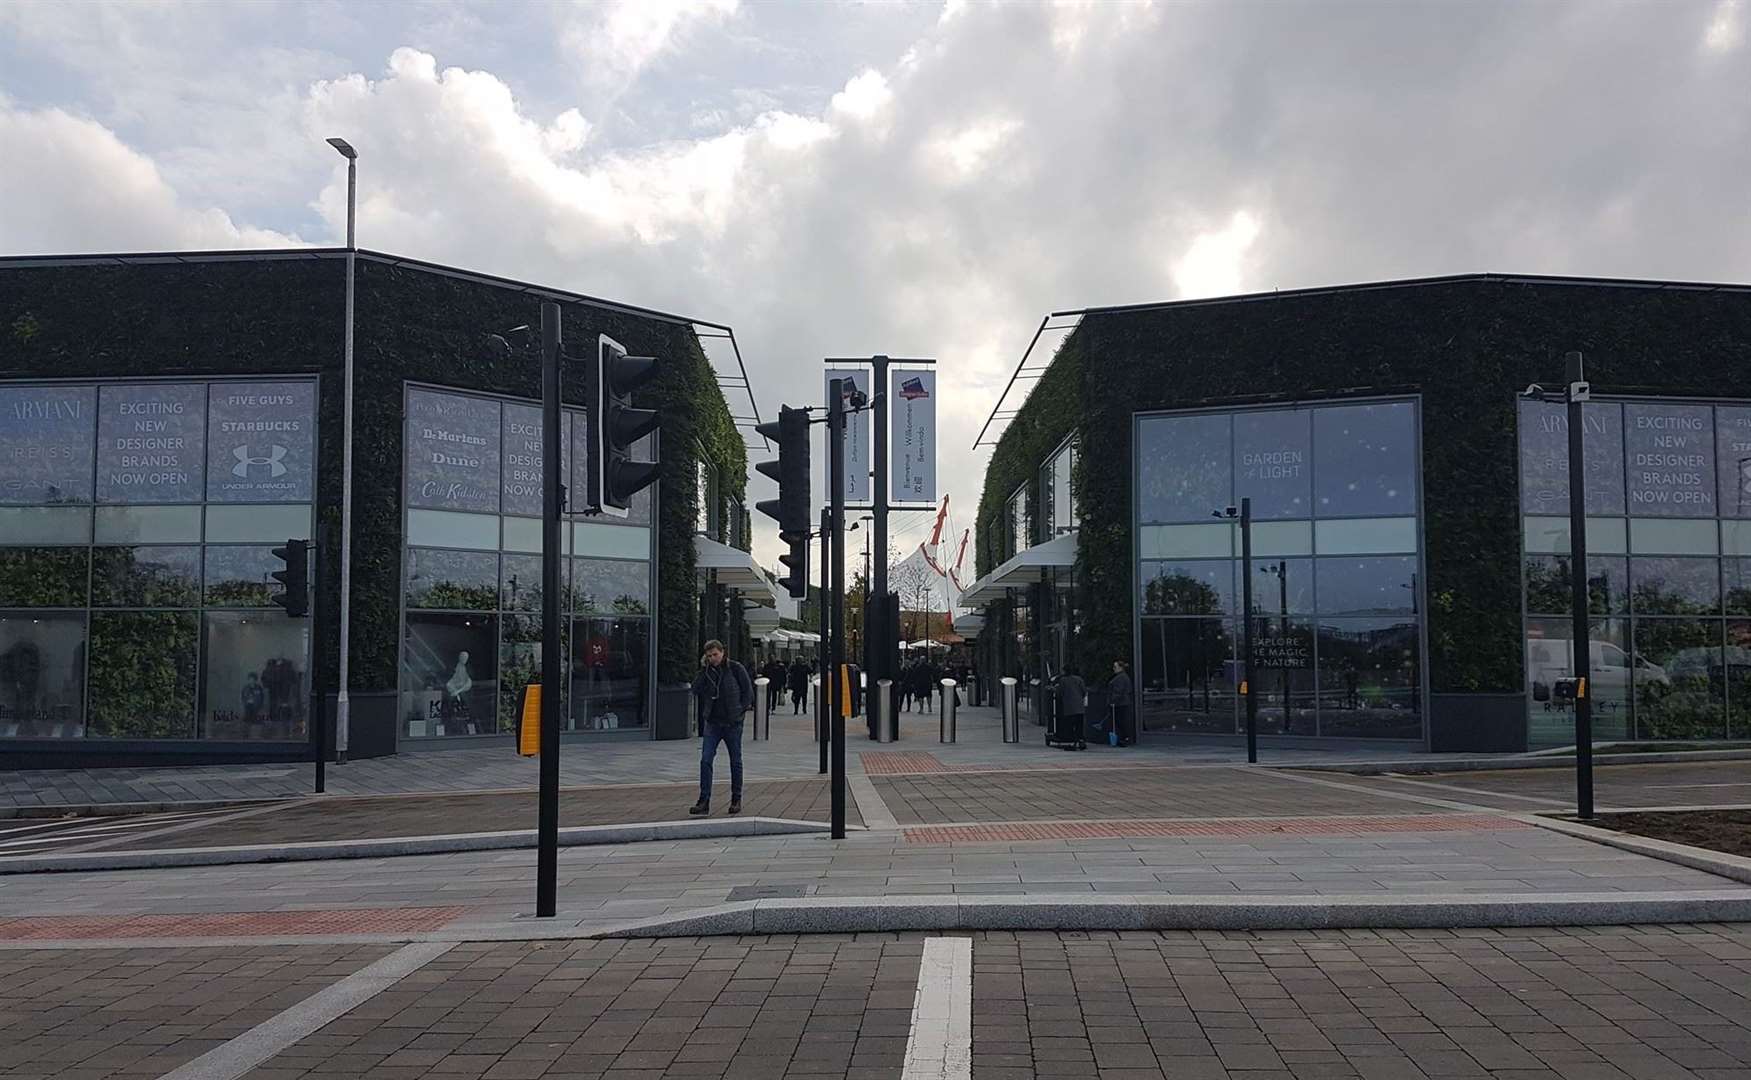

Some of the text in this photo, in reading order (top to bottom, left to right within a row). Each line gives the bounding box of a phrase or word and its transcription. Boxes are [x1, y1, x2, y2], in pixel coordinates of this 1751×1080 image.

[228, 395, 294, 405] FIVE GUYS
[9, 400, 81, 420] ARMANI
[120, 402, 184, 415] EXCITING
[135, 420, 168, 433] NEW
[221, 421, 300, 432] STARBUCKS
[1637, 416, 1703, 430] EXCITING
[511, 423, 543, 437] EXCIT
[117, 437, 184, 450] DESIGNER
[524, 441, 543, 452] NE
[1654, 436, 1687, 448] NEW
[122, 455, 178, 467] BRANDS
[431, 451, 480, 468] Dune
[509, 454, 543, 467] DESIG
[1243, 450, 1303, 466] GARDEN
[1636, 453, 1705, 467] DESIGNER
[1259, 465, 1300, 479] LIGHT
[1643, 471, 1701, 485] BRANDS
[4, 479, 80, 490] GANT
[111, 472, 188, 486] NOW OPEN
[504, 484, 535, 497] NOW
[1633, 490, 1711, 503] NOW OPEN
[1263, 658, 1306, 667] NATURE
